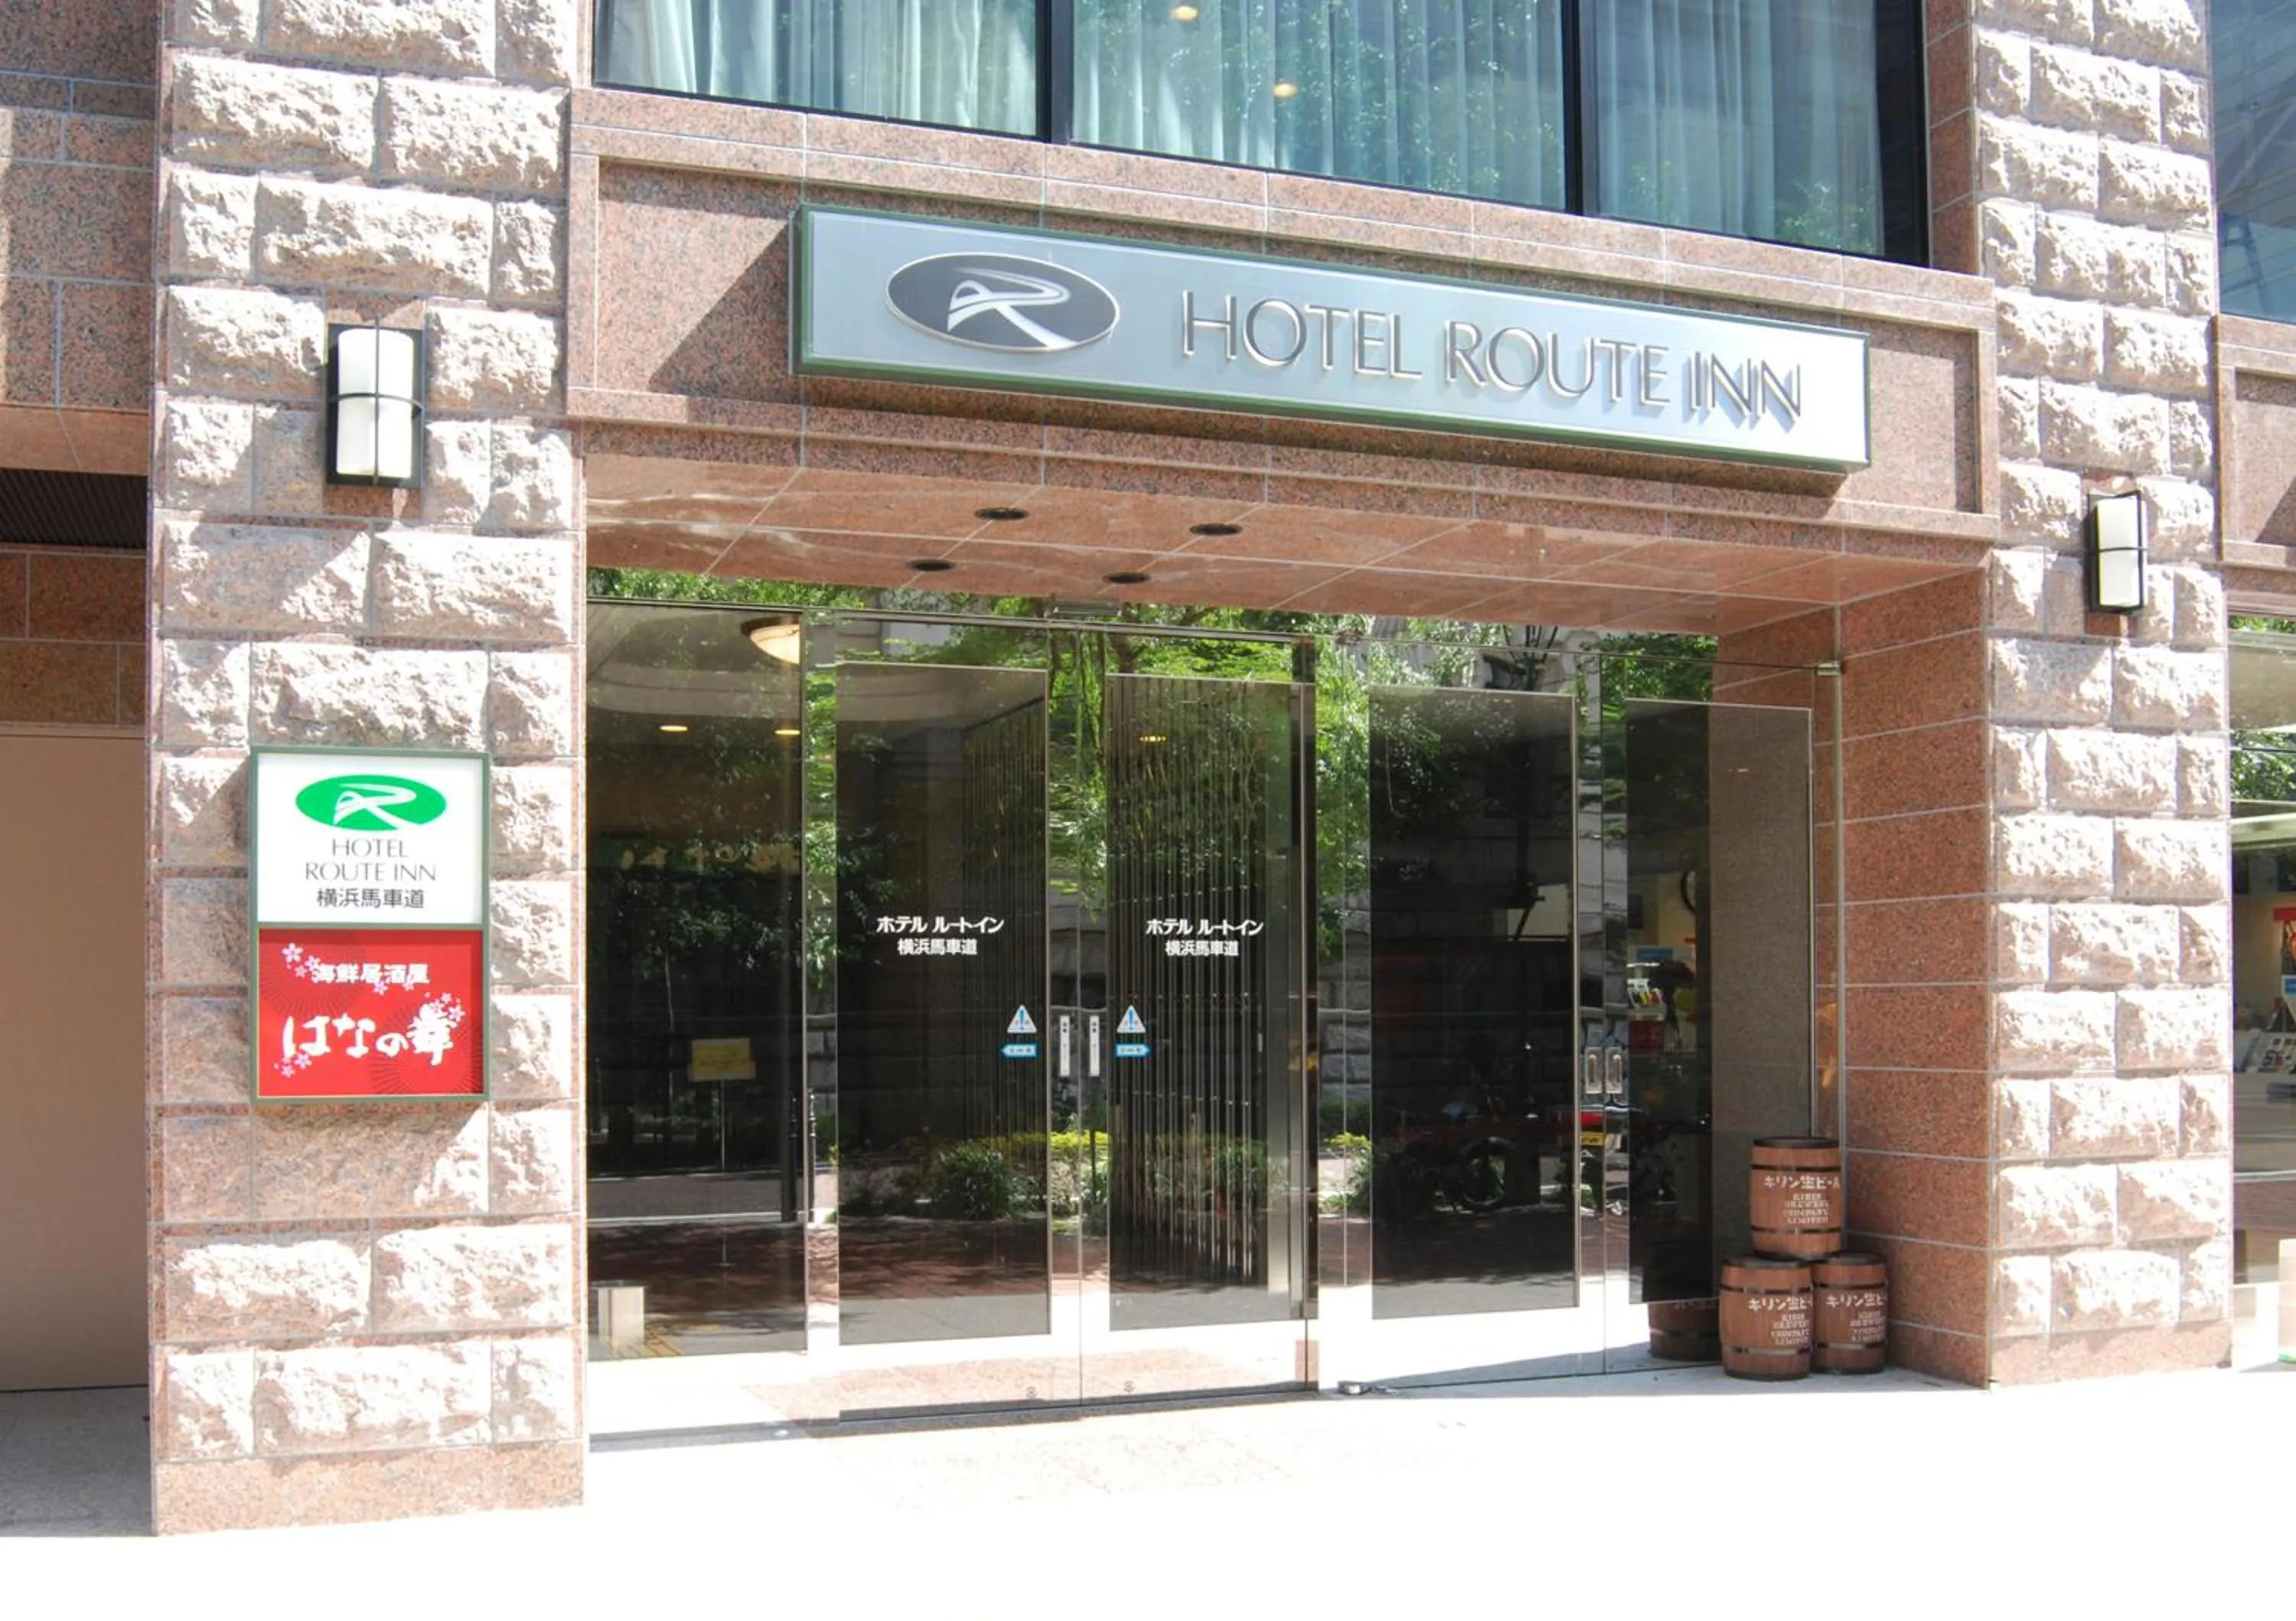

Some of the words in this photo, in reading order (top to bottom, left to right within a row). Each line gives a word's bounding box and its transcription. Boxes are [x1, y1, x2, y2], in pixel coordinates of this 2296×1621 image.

[1182, 289, 1423, 380] HOTEL
[1443, 319, 1672, 408] ROUTE
[1688, 351, 1802, 422] INN
[331, 837, 409, 858] HOTEL
[305, 861, 386, 882] ROUTE
[393, 863, 437, 882] INN
[316, 887, 426, 909] 横浜馬車道
[875, 916, 928, 934] ホテル
[931, 916, 1005, 934] ルートイン
[1145, 918, 1194, 935] ホテル
[1197, 918, 1264, 936] ルートイン
[897, 938, 978, 956] 横浜馬車道
[1165, 940, 1240, 957] 横浜馬車道
[312, 964, 430, 984] 海鮮居酒屋
[282, 1003, 458, 1066] はなの舞
